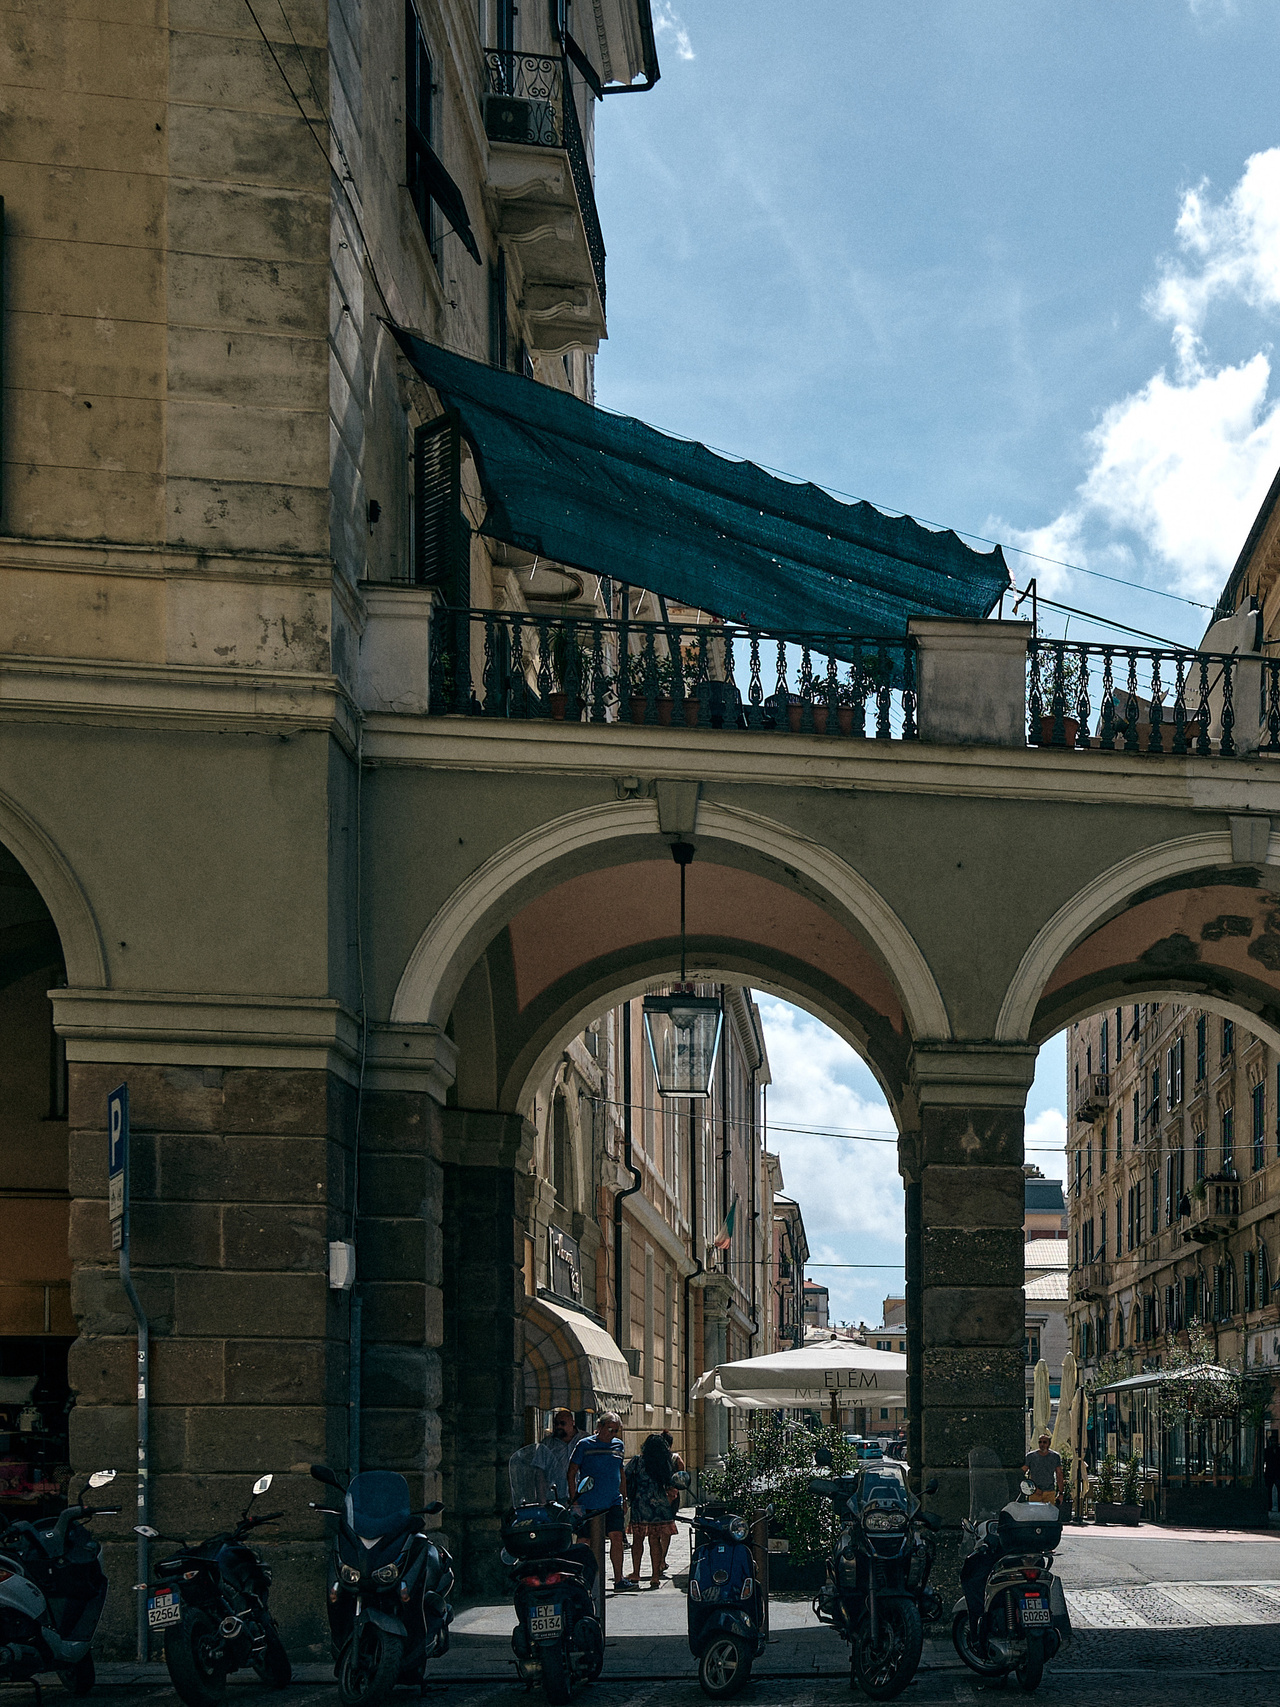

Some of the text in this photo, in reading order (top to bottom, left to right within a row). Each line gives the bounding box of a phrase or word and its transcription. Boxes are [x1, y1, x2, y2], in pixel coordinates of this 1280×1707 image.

[110, 1097, 122, 1167] P
[824, 1368, 878, 1389] ELÉM
[155, 1595, 167, 1607] ET
[1027, 1599, 1038, 1609] ET
[149, 1606, 179, 1623] 32564
[1023, 1611, 1049, 1622] 60269
[532, 1617, 560, 1631] 36134
